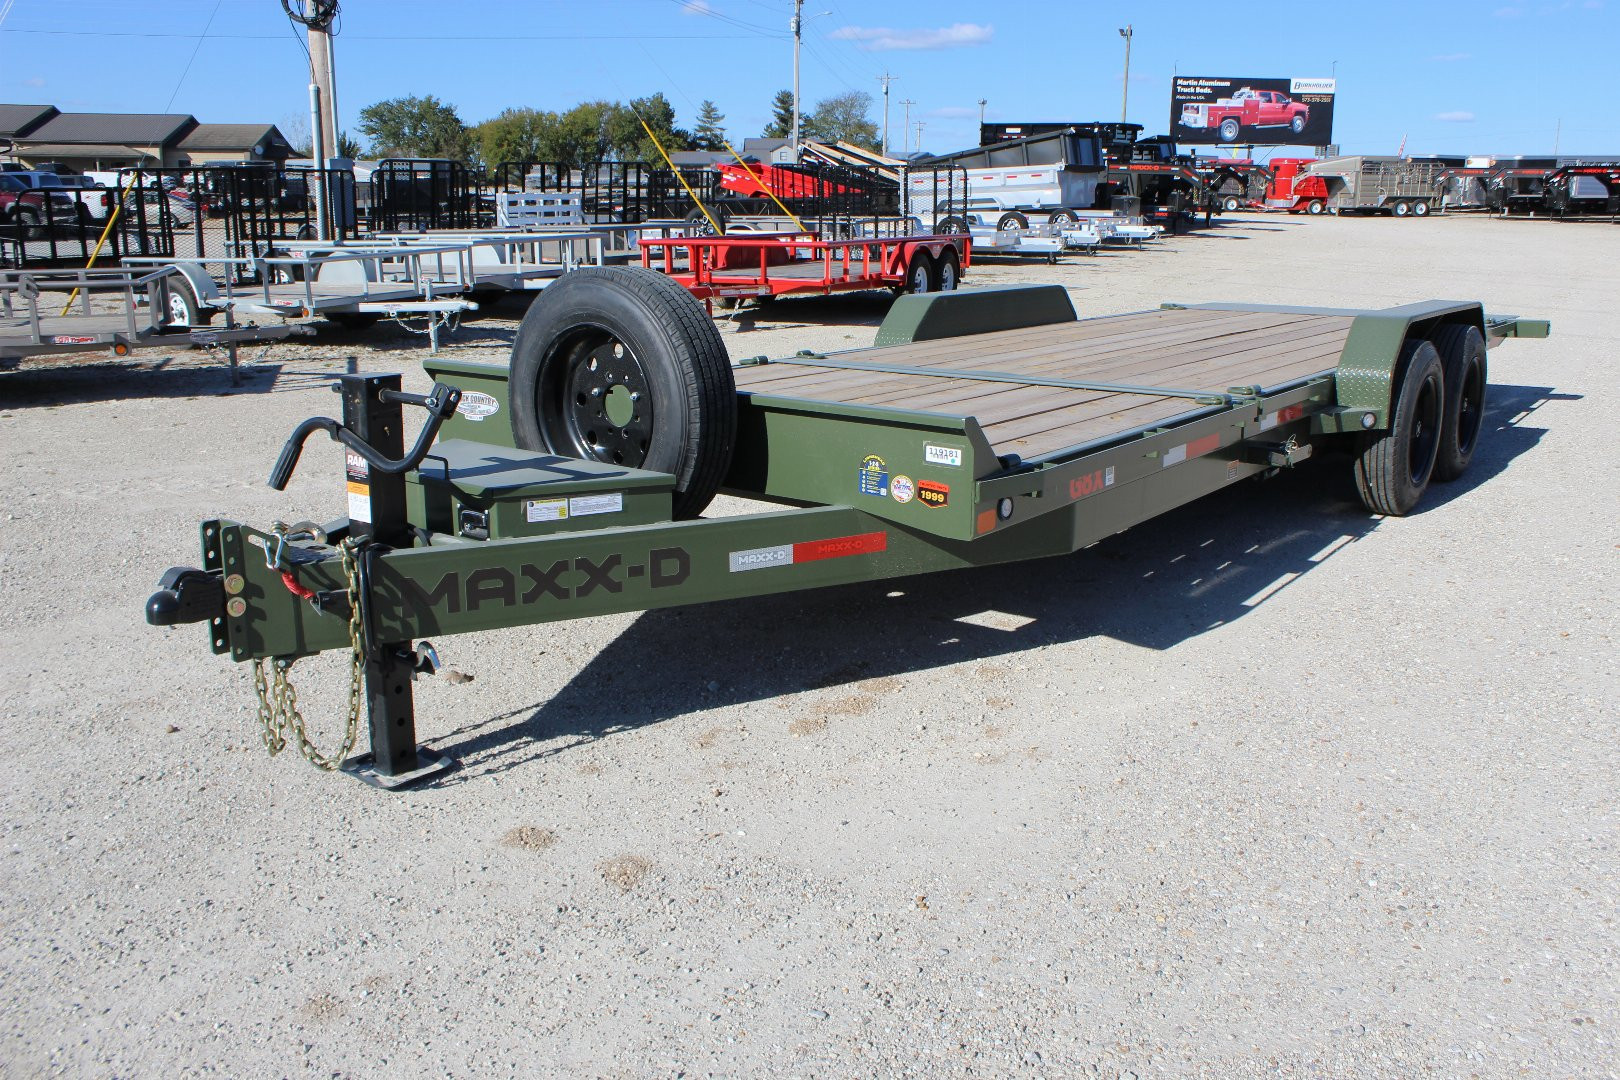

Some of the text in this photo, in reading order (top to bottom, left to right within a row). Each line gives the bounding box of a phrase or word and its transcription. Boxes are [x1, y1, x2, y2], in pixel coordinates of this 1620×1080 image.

[470, 395, 495, 406] COUNTRY
[929, 447, 958, 458] 119181
[347, 455, 366, 469] RAM
[921, 490, 945, 502] 1999
[817, 540, 863, 554] MAXX-D
[738, 550, 785, 565] MAXX-D
[402, 546, 691, 613] MAXX-D
